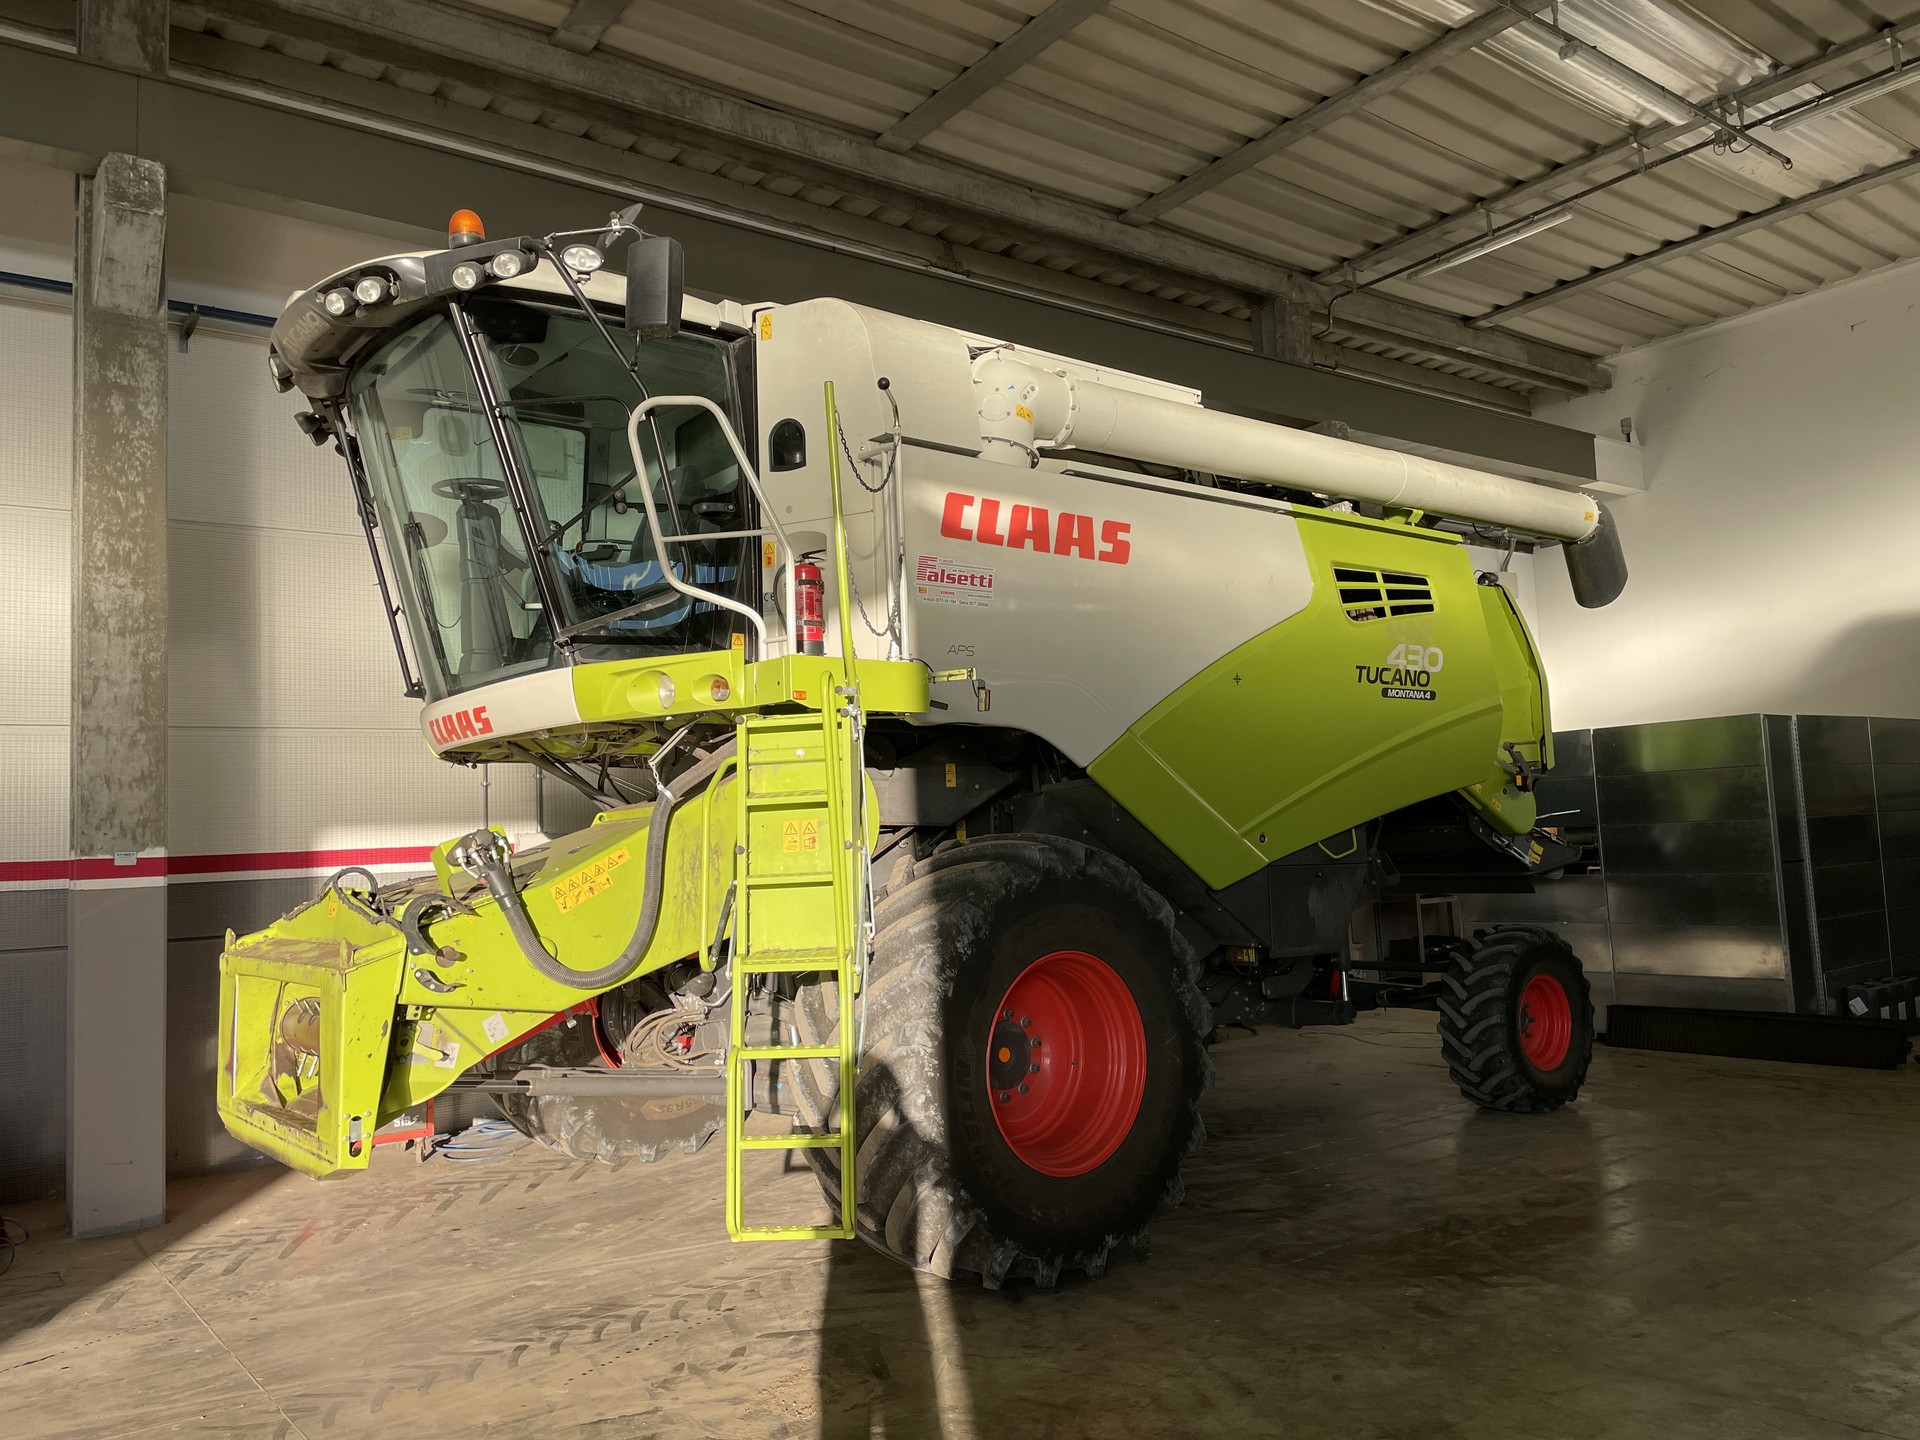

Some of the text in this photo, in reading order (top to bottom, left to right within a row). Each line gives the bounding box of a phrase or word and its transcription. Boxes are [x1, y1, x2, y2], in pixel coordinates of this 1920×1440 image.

[940, 491, 1131, 565] CLAAS
[916, 555, 993, 588] Falsetti
[947, 644, 975, 657] APS
[1386, 643, 1444, 673] 430
[1355, 665, 1431, 687] TUCANO
[1387, 689, 1424, 699] MONTANA
[428, 705, 494, 746] CLAAS
